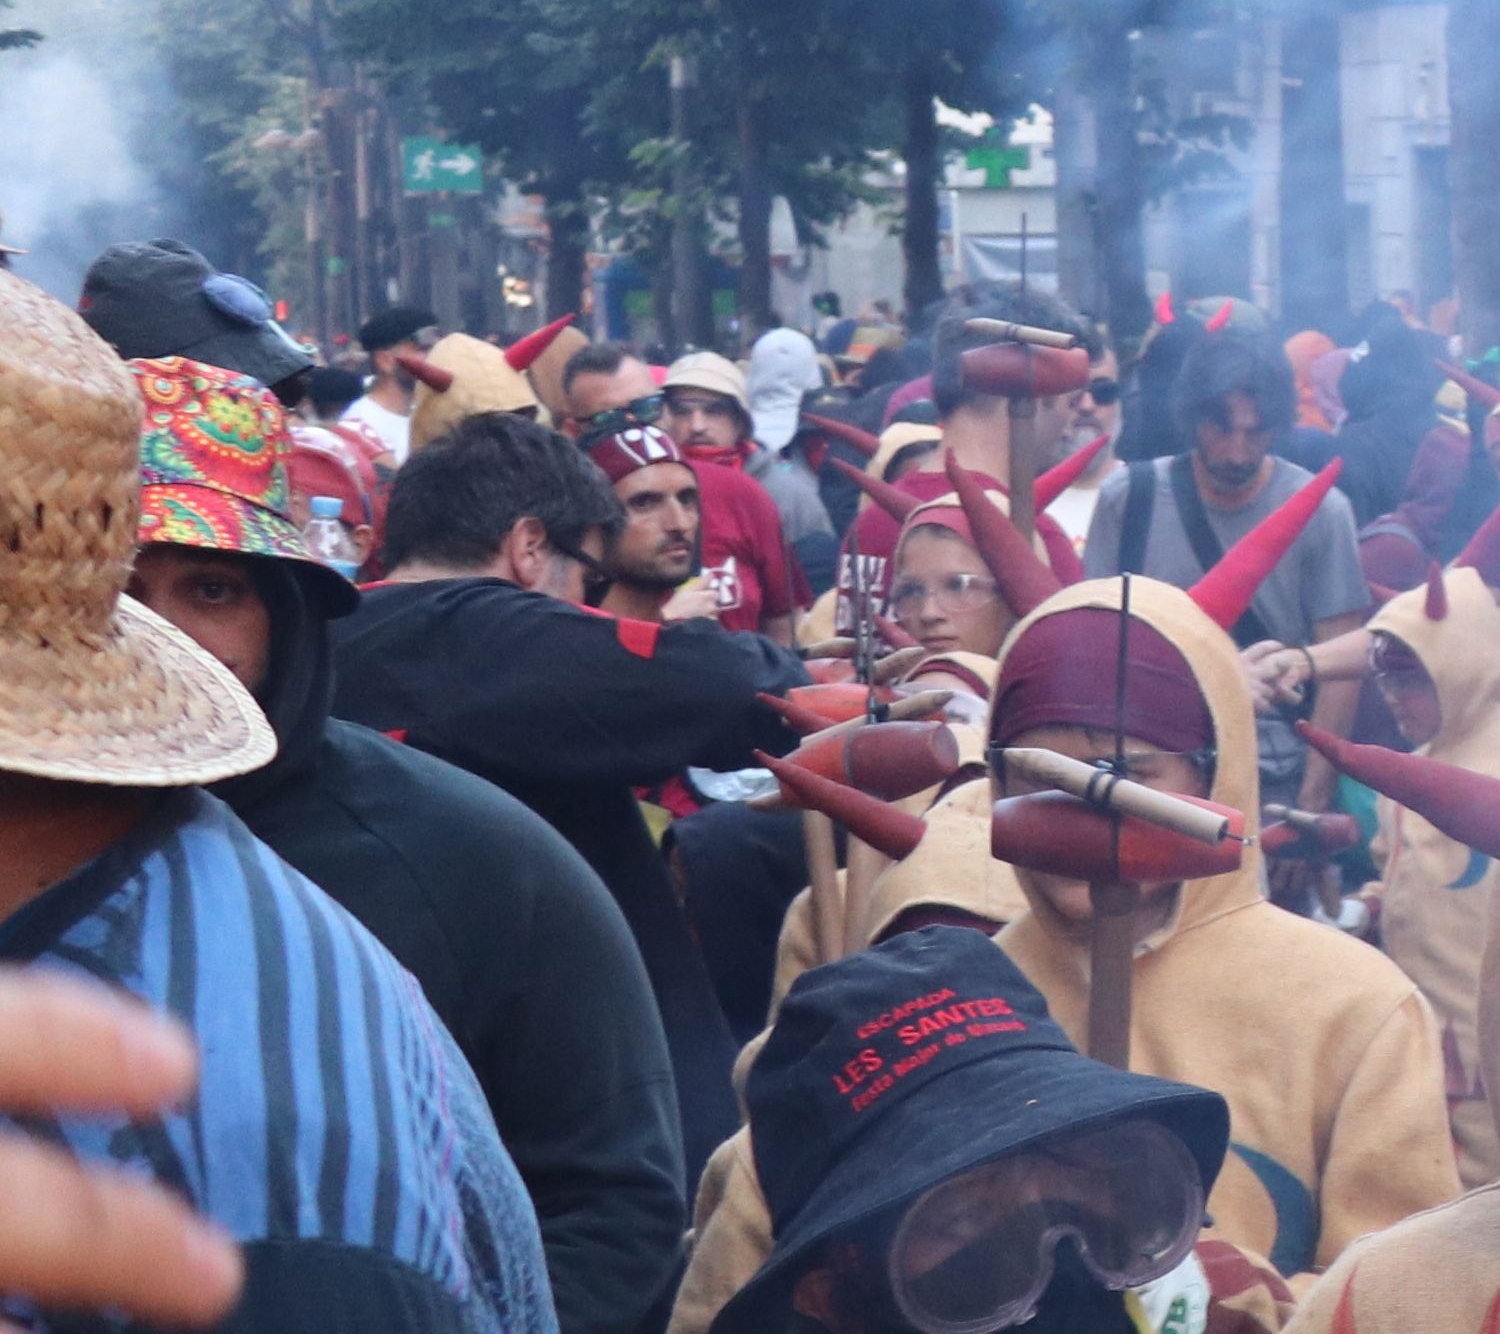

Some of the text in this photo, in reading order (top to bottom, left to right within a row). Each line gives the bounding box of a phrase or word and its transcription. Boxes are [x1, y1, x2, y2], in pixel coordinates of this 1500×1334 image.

[832, 997, 1014, 1094] LES SANTES
[856, 987, 957, 1040] ESCAPADA
